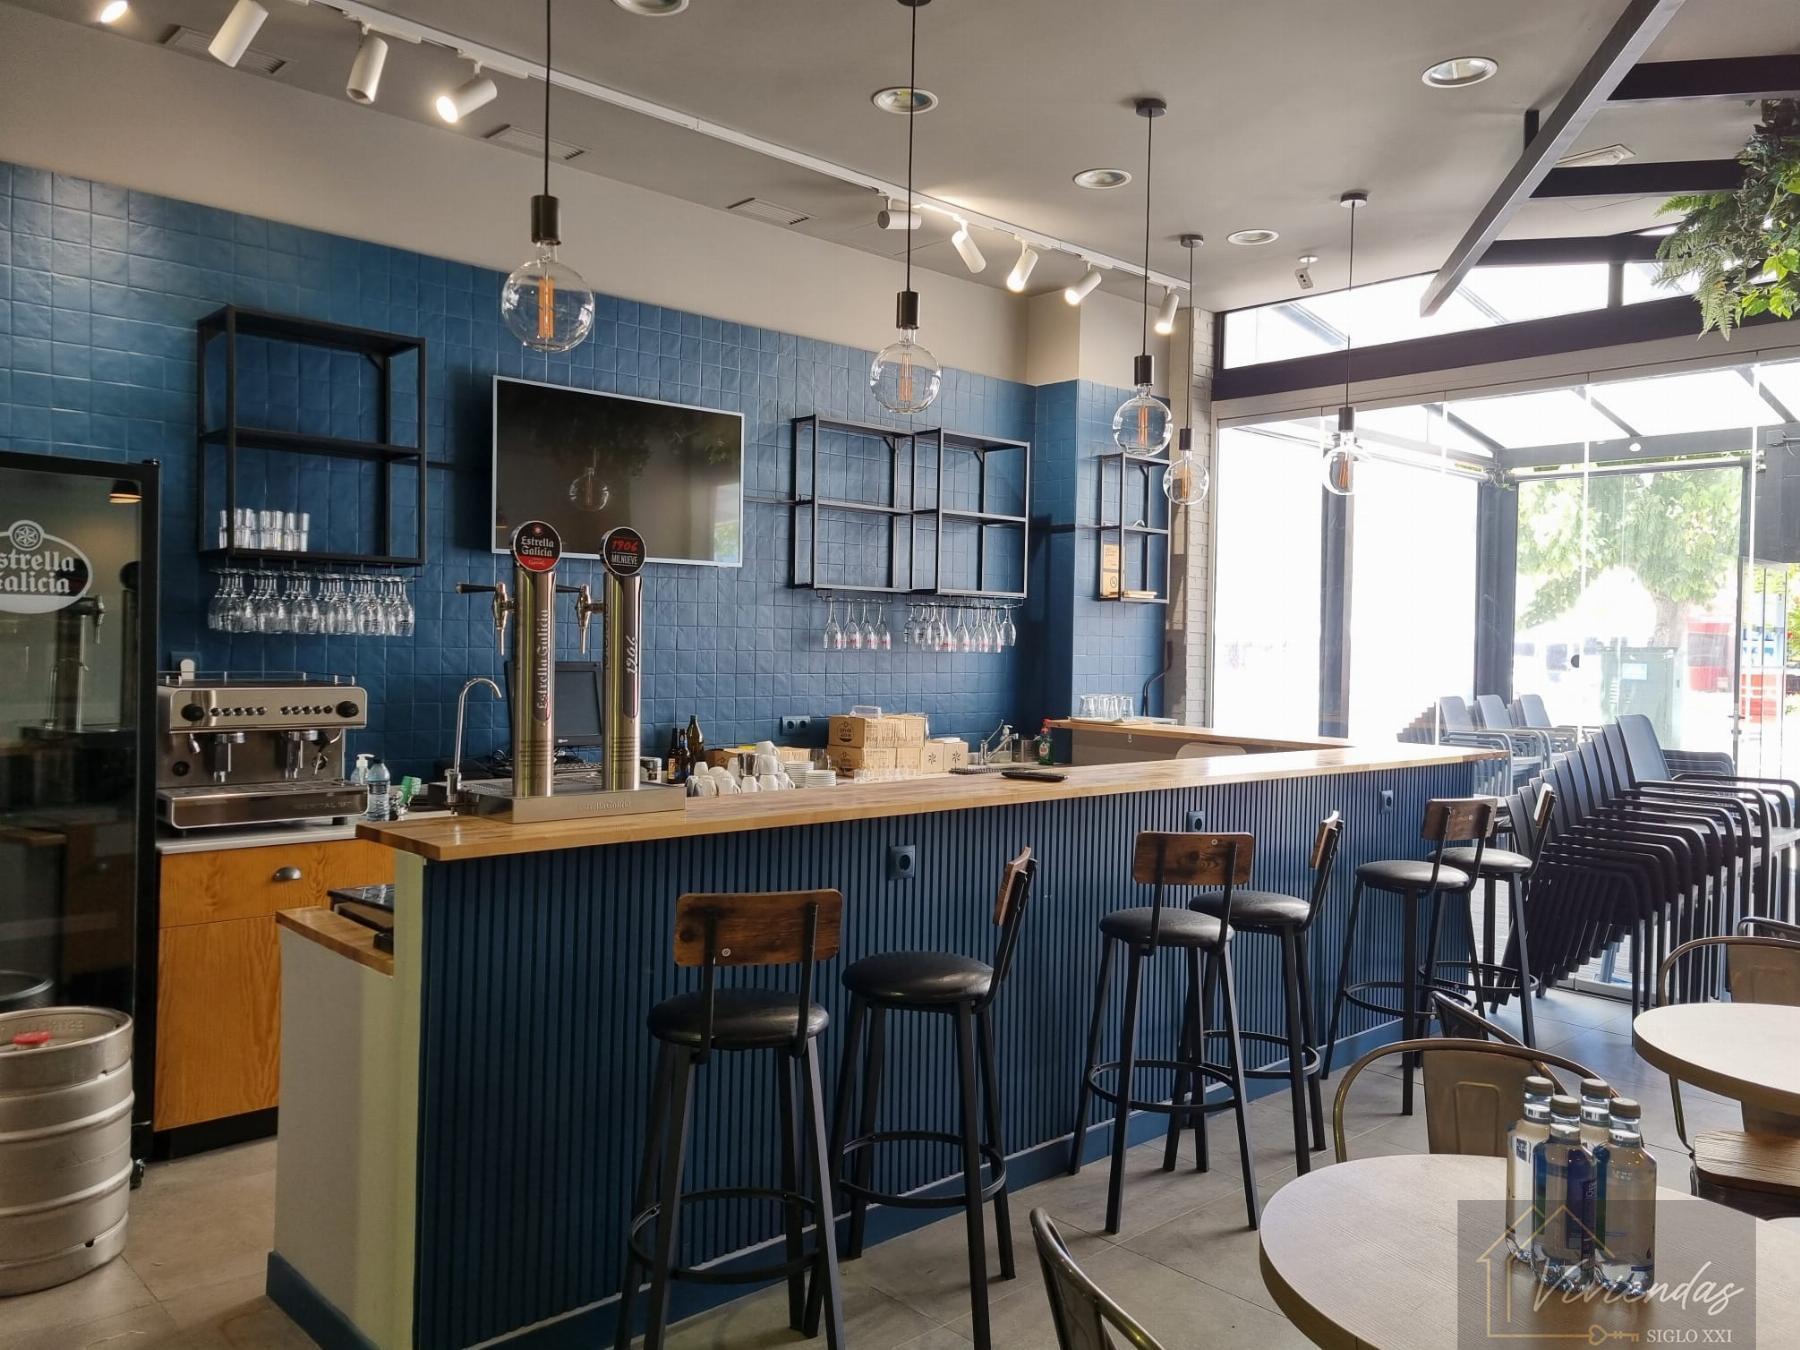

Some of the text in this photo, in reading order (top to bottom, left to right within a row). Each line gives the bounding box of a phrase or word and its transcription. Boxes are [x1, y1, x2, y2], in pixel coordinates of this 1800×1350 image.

[521, 535, 555, 548] Estrella
[612, 539, 639, 552] 1906
[0, 548, 75, 571] strella
[521, 545, 553, 557] Galicia
[0, 571, 71, 593] alicia
[536, 609, 549, 709] Estrella Galicia
